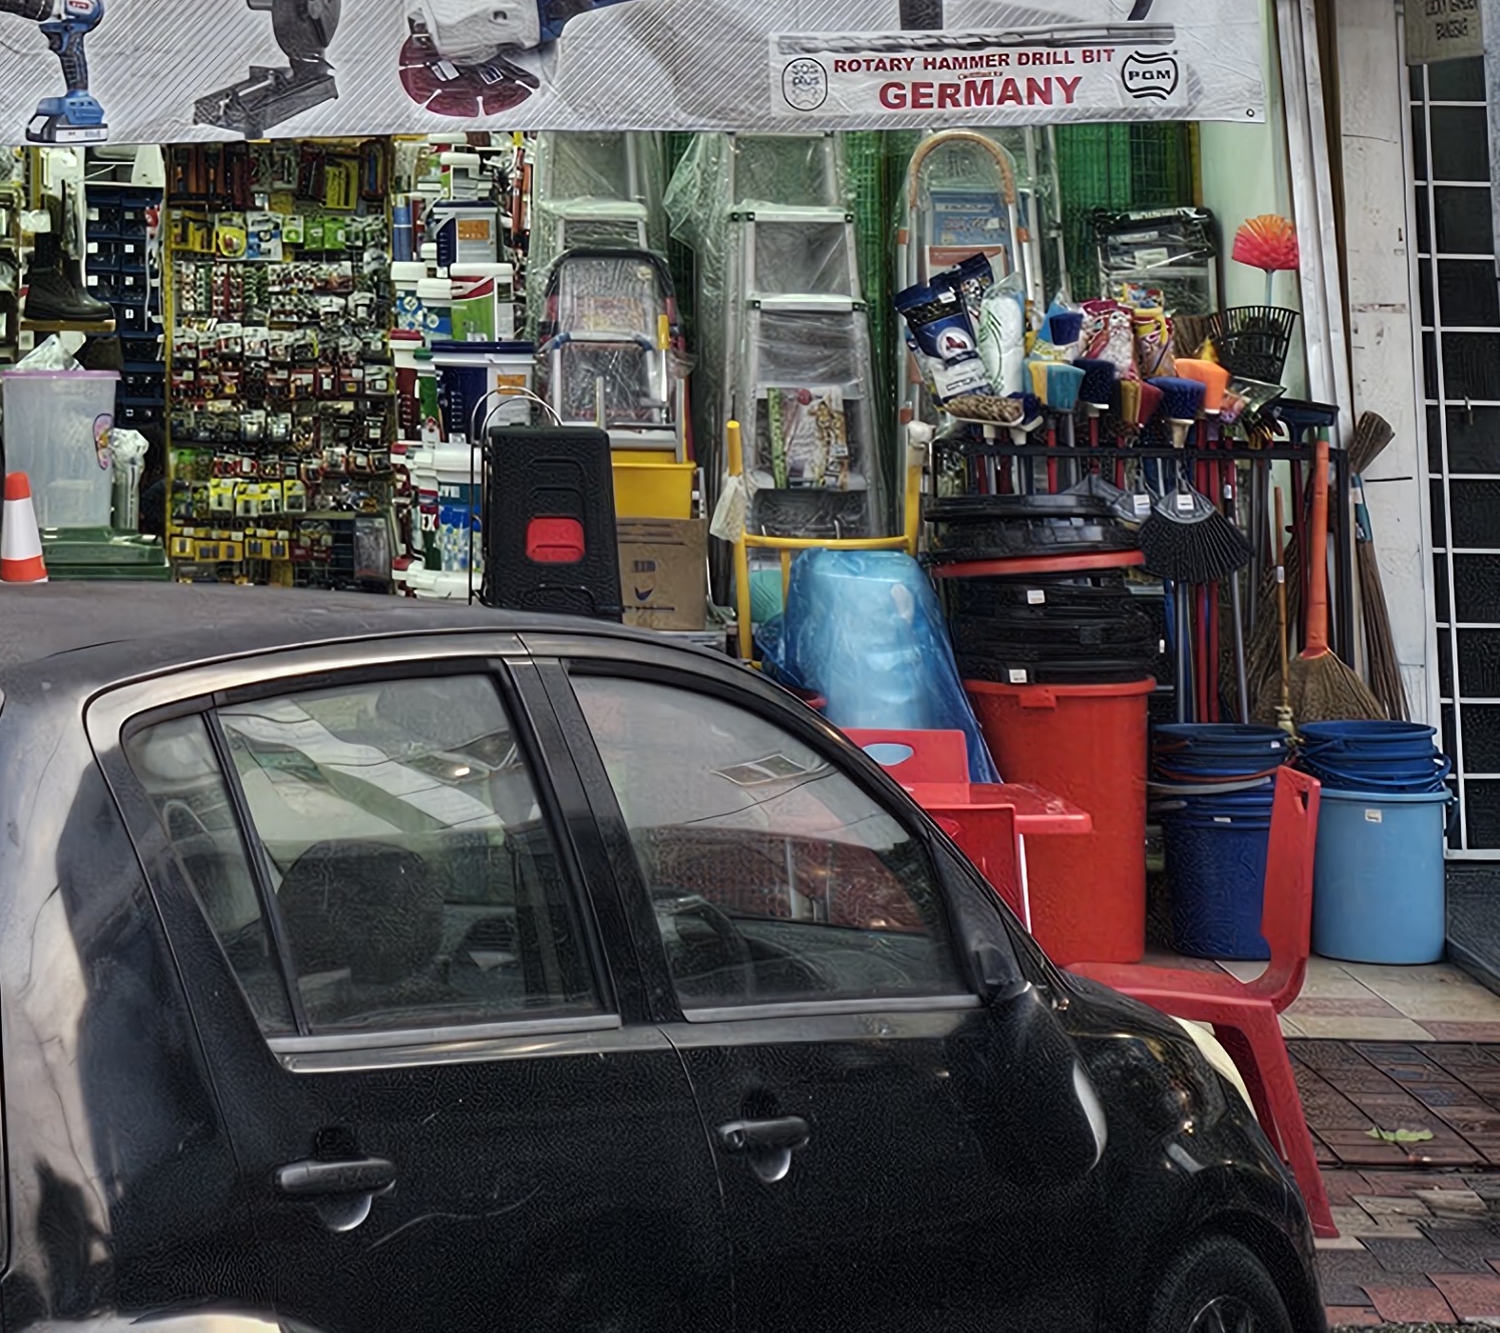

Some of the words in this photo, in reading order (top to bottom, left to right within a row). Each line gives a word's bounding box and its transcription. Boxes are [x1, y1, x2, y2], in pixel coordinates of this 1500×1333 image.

[834, 58, 915, 74] ROTARY
[923, 54, 1010, 71] HAMMER
[1018, 51, 1075, 67] DRILL
[1082, 48, 1115, 64] BIT
[879, 76, 1082, 110] GERMANY
